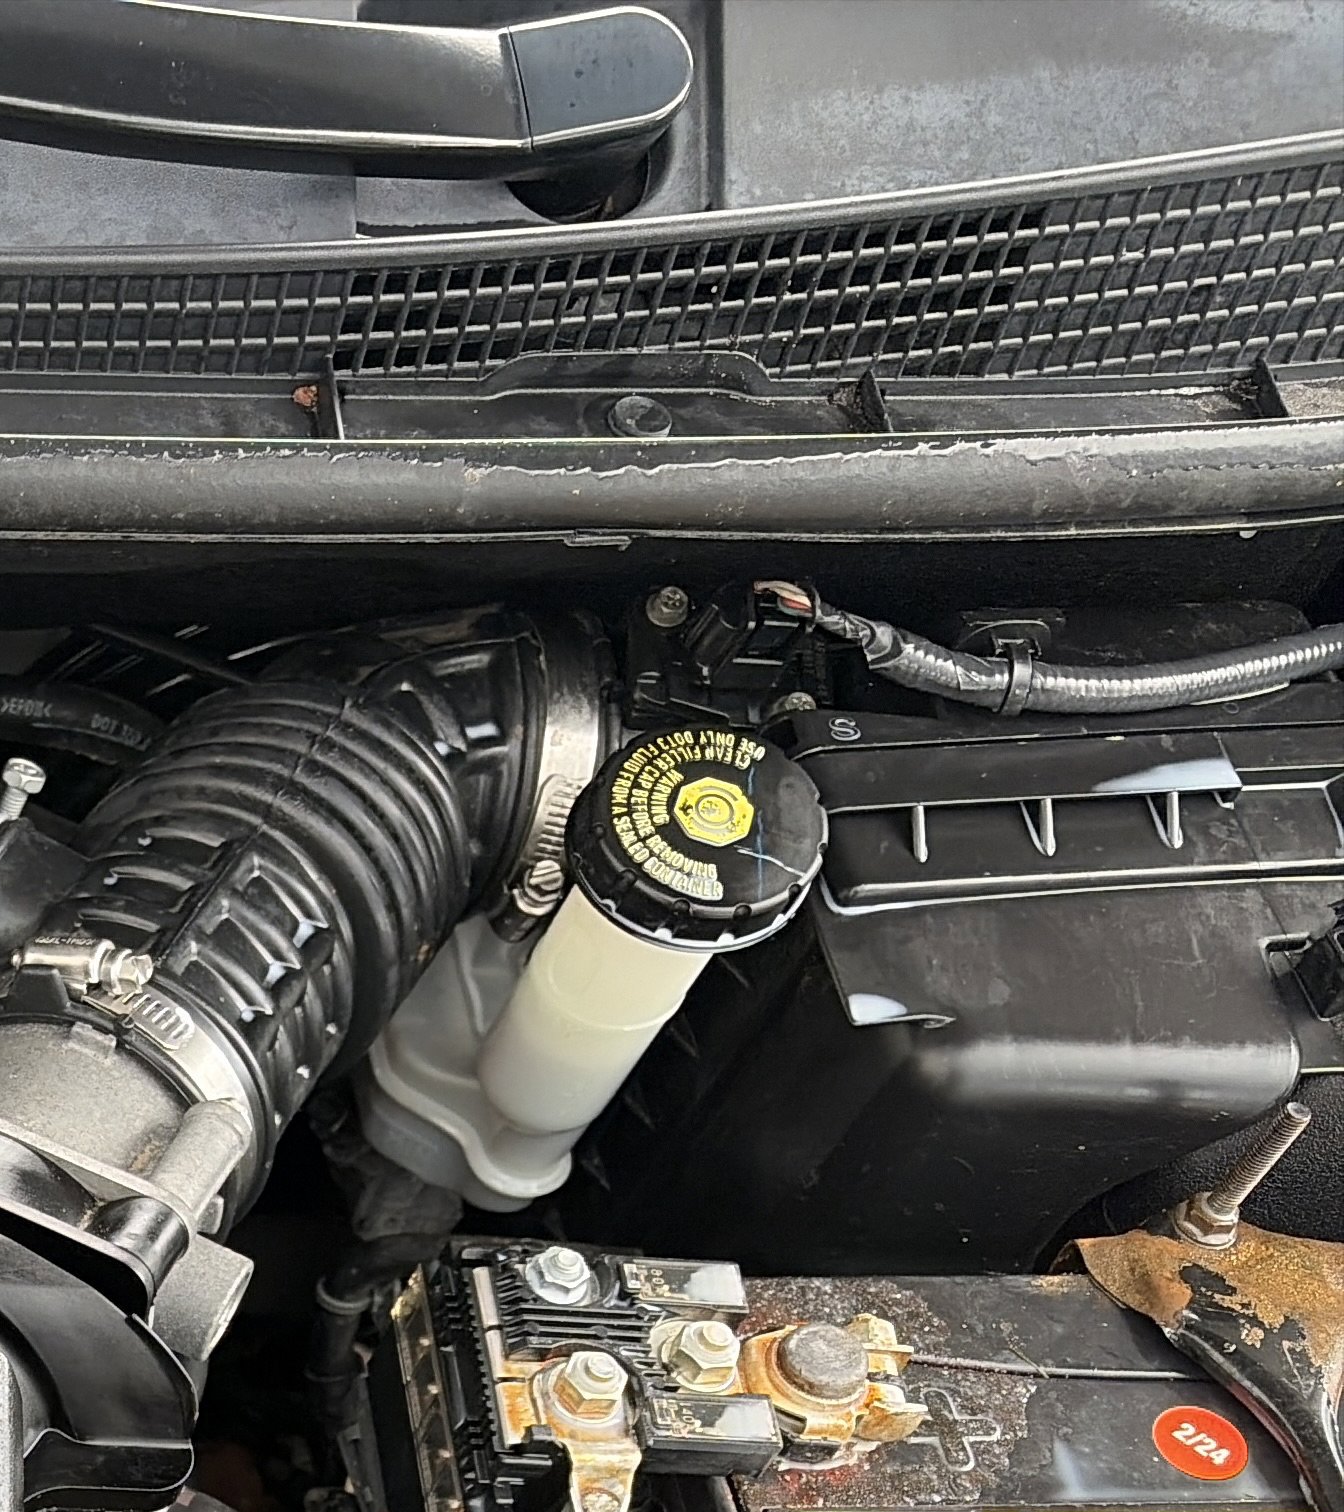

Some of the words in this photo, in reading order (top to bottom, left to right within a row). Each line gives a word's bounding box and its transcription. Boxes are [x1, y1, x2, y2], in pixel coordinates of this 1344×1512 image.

[700, 730, 736, 750] ONLY
[741, 737, 766, 761] USE
[624, 743, 654, 771] FLUID
[653, 744, 703, 771] FILLER
[704, 746, 752, 771] CLEAN
[612, 772, 632, 804] FROM
[637, 765, 661, 790] CAP
[612, 804, 628, 815] A
[652, 769, 685, 826] WARNING
[631, 789, 655, 838] BEFORE
[613, 816, 649, 863] SEALED
[645, 834, 718, 881] REMOVING
[642, 857, 724, 901] CONTAINER
[1172, 1422, 1230, 1466] 2/24
